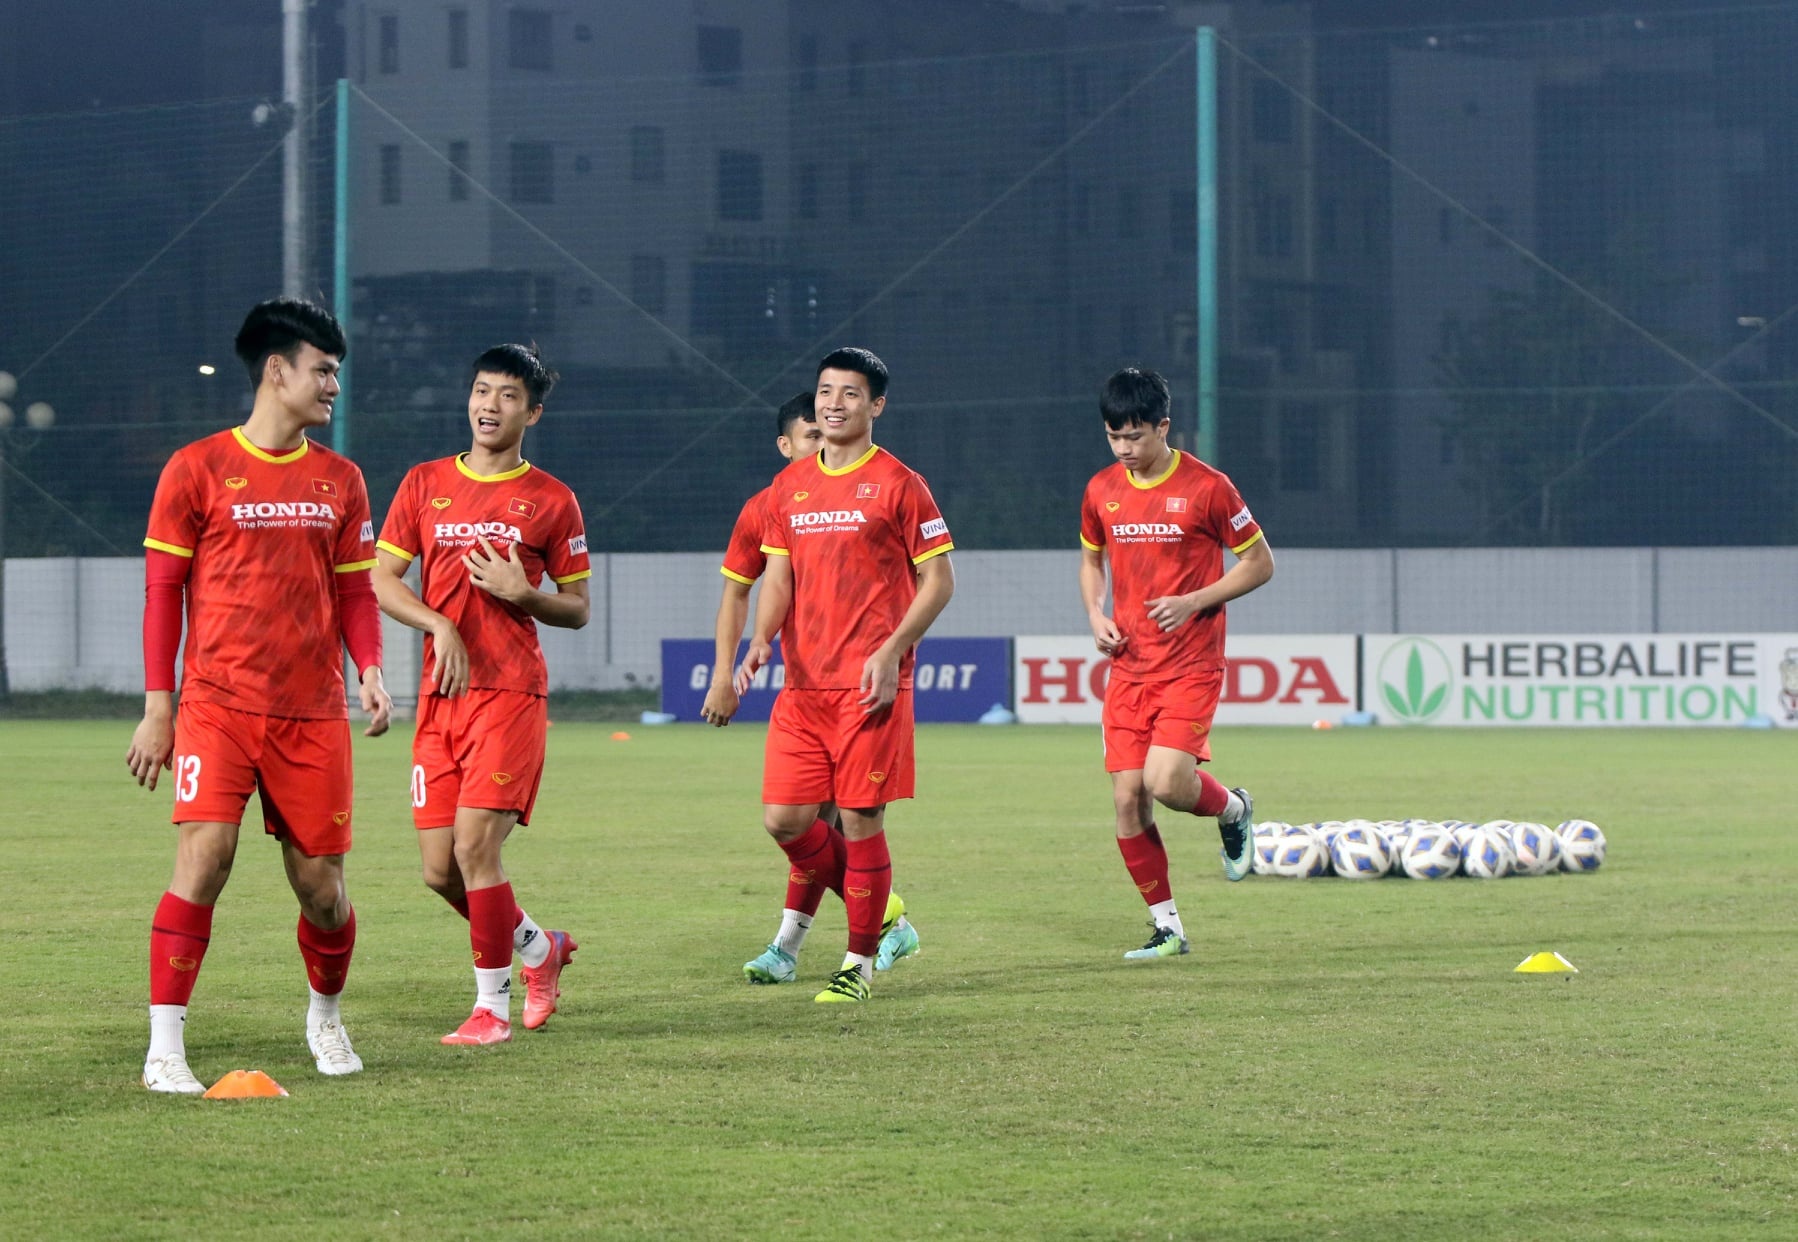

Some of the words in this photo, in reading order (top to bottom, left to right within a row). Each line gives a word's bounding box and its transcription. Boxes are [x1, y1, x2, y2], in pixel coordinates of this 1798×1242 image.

[231, 502, 337, 520] HONDA
[790, 510, 867, 527] HONDA
[237, 521, 256, 530] The
[257, 519, 287, 529] Power
[288, 518, 299, 527] of
[301, 518, 333, 530] Dreams
[434, 521, 523, 544] HONDA
[806, 526, 825, 534] Power
[1111, 523, 1184, 535] HONDA
[437, 539, 454, 548] The
[1462, 641, 1757, 678] HERBALIFE
[1021, 656, 1349, 704] HDA
[1462, 684, 1758, 722] NUTRITION
[176, 754, 201, 803] 13
[410, 764, 427, 809] 0
